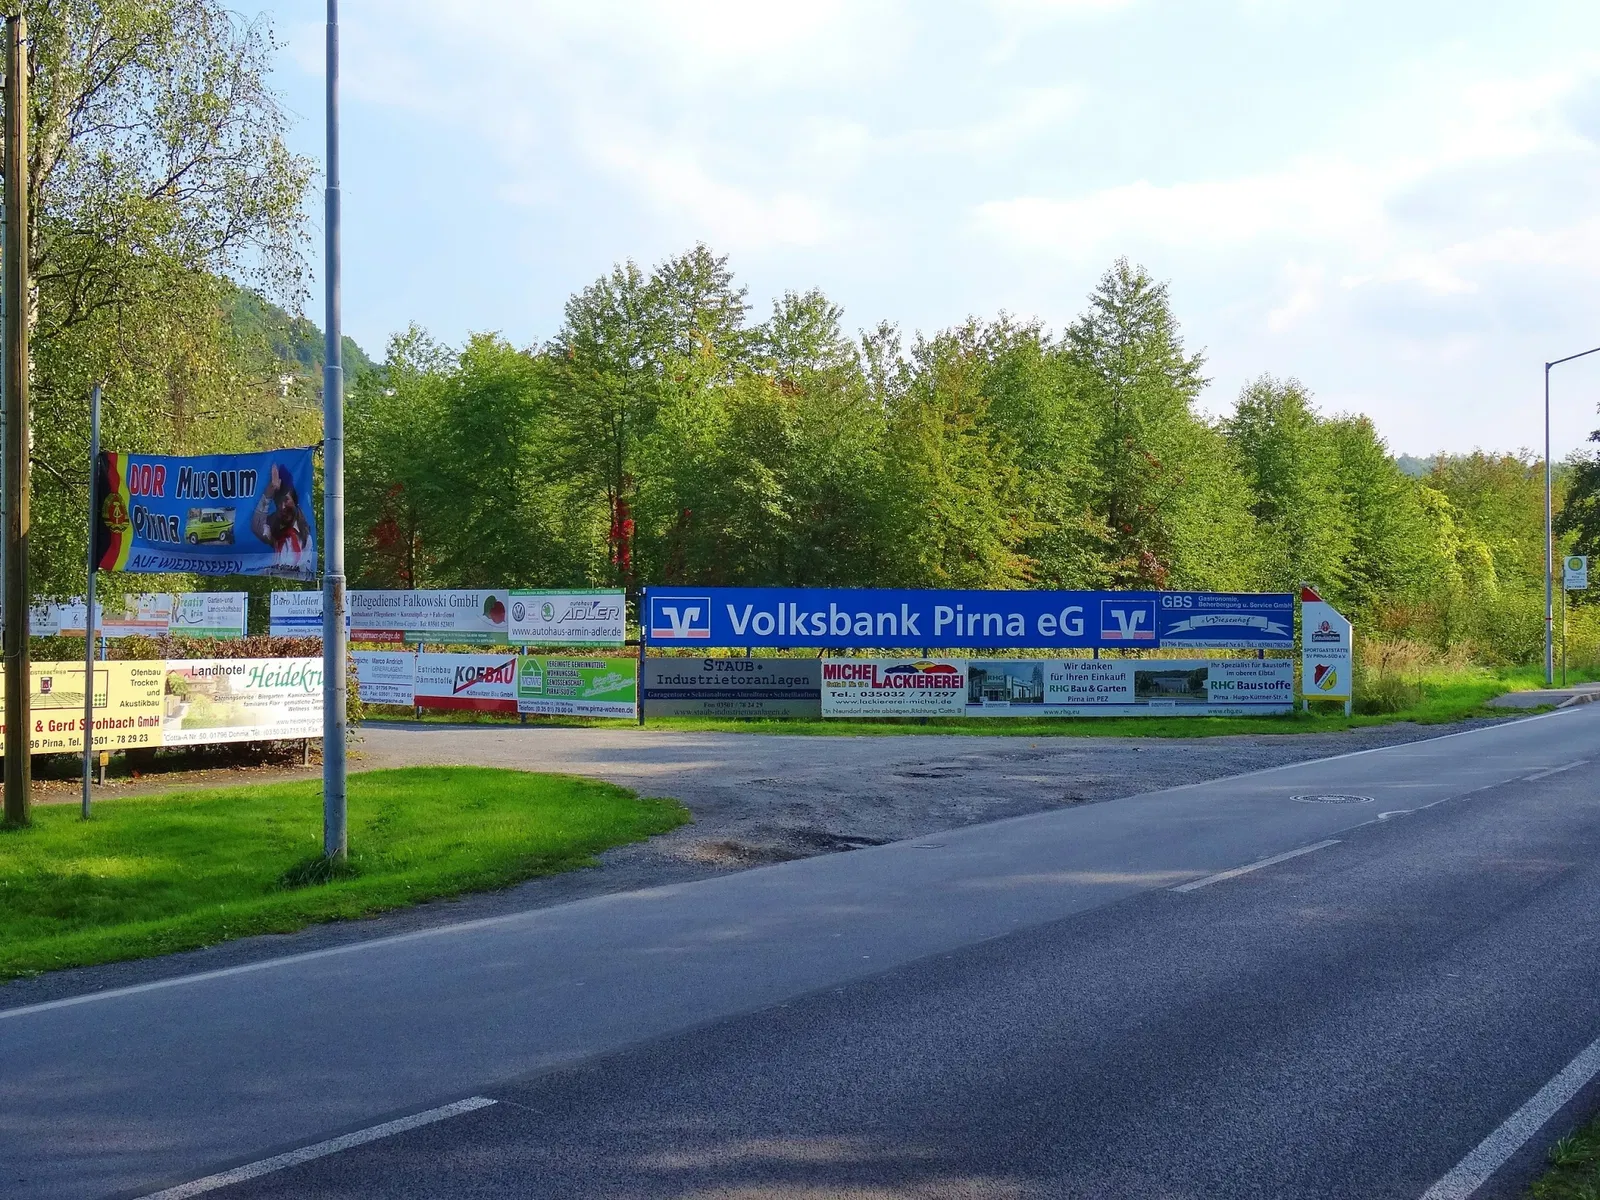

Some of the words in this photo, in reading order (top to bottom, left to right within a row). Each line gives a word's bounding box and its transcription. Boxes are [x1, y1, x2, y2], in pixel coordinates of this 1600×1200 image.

[130, 464, 166, 498] DDR
[175, 466, 258, 499] Museum
[133, 505, 180, 544] Pirna
[132, 554, 159, 568] AUF
[160, 558, 243, 573] WIEDERSEHEN
[352, 594, 400, 609] Pflegedienst
[403, 594, 446, 607] Falkowski
[450, 594, 479, 607] GmbH
[1162, 595, 1192, 608] GBS
[557, 606, 620, 623] ADLER
[726, 603, 921, 636] Volksbank
[934, 604, 1025, 637] Pirna
[1037, 606, 1084, 637] eG
[512, 626, 622, 636] www.autohaus-armin-adler.de
[192, 664, 246, 676] Landhotel
[418, 666, 451, 674] Estrichbau
[704, 659, 754, 672] STAUB
[824, 664, 871, 680] MICHEL
[1080, 662, 1113, 670] danken
[131, 669, 161, 677] Ofenbau
[455, 666, 514, 684] KOEBAU
[872, 665, 964, 689] LACKIEREREI
[1050, 673, 1063, 681] für
[1066, 673, 1089, 681] Ihren
[1092, 673, 1126, 681] Einkauf!
[416, 676, 453, 684] Dämmstoffe
[522, 677, 542, 686] VGWG
[657, 674, 810, 688] Industrietoranlagen
[1211, 681, 1235, 690] RHG
[1237, 680, 1291, 690] Baustoffe
[1050, 685, 1069, 693] RHG
[1071, 685, 1087, 693] Bau
[1088, 685, 1096, 693] &
[1096, 685, 1127, 693] Garten
[120, 700, 160, 708] Akustikbau
[576, 706, 633, 714] www.pirna-wohnen.de
[36, 720, 43, 732] &
[49, 719, 75, 732] Gerd
[80, 716, 134, 731] Srohbach
[138, 716, 160, 728] GmbH
[42, 738, 66, 748] Pirna,
[68, 738, 82, 746] Tel.
[128, 735, 137, 743] 29
[140, 734, 149, 742] 23
